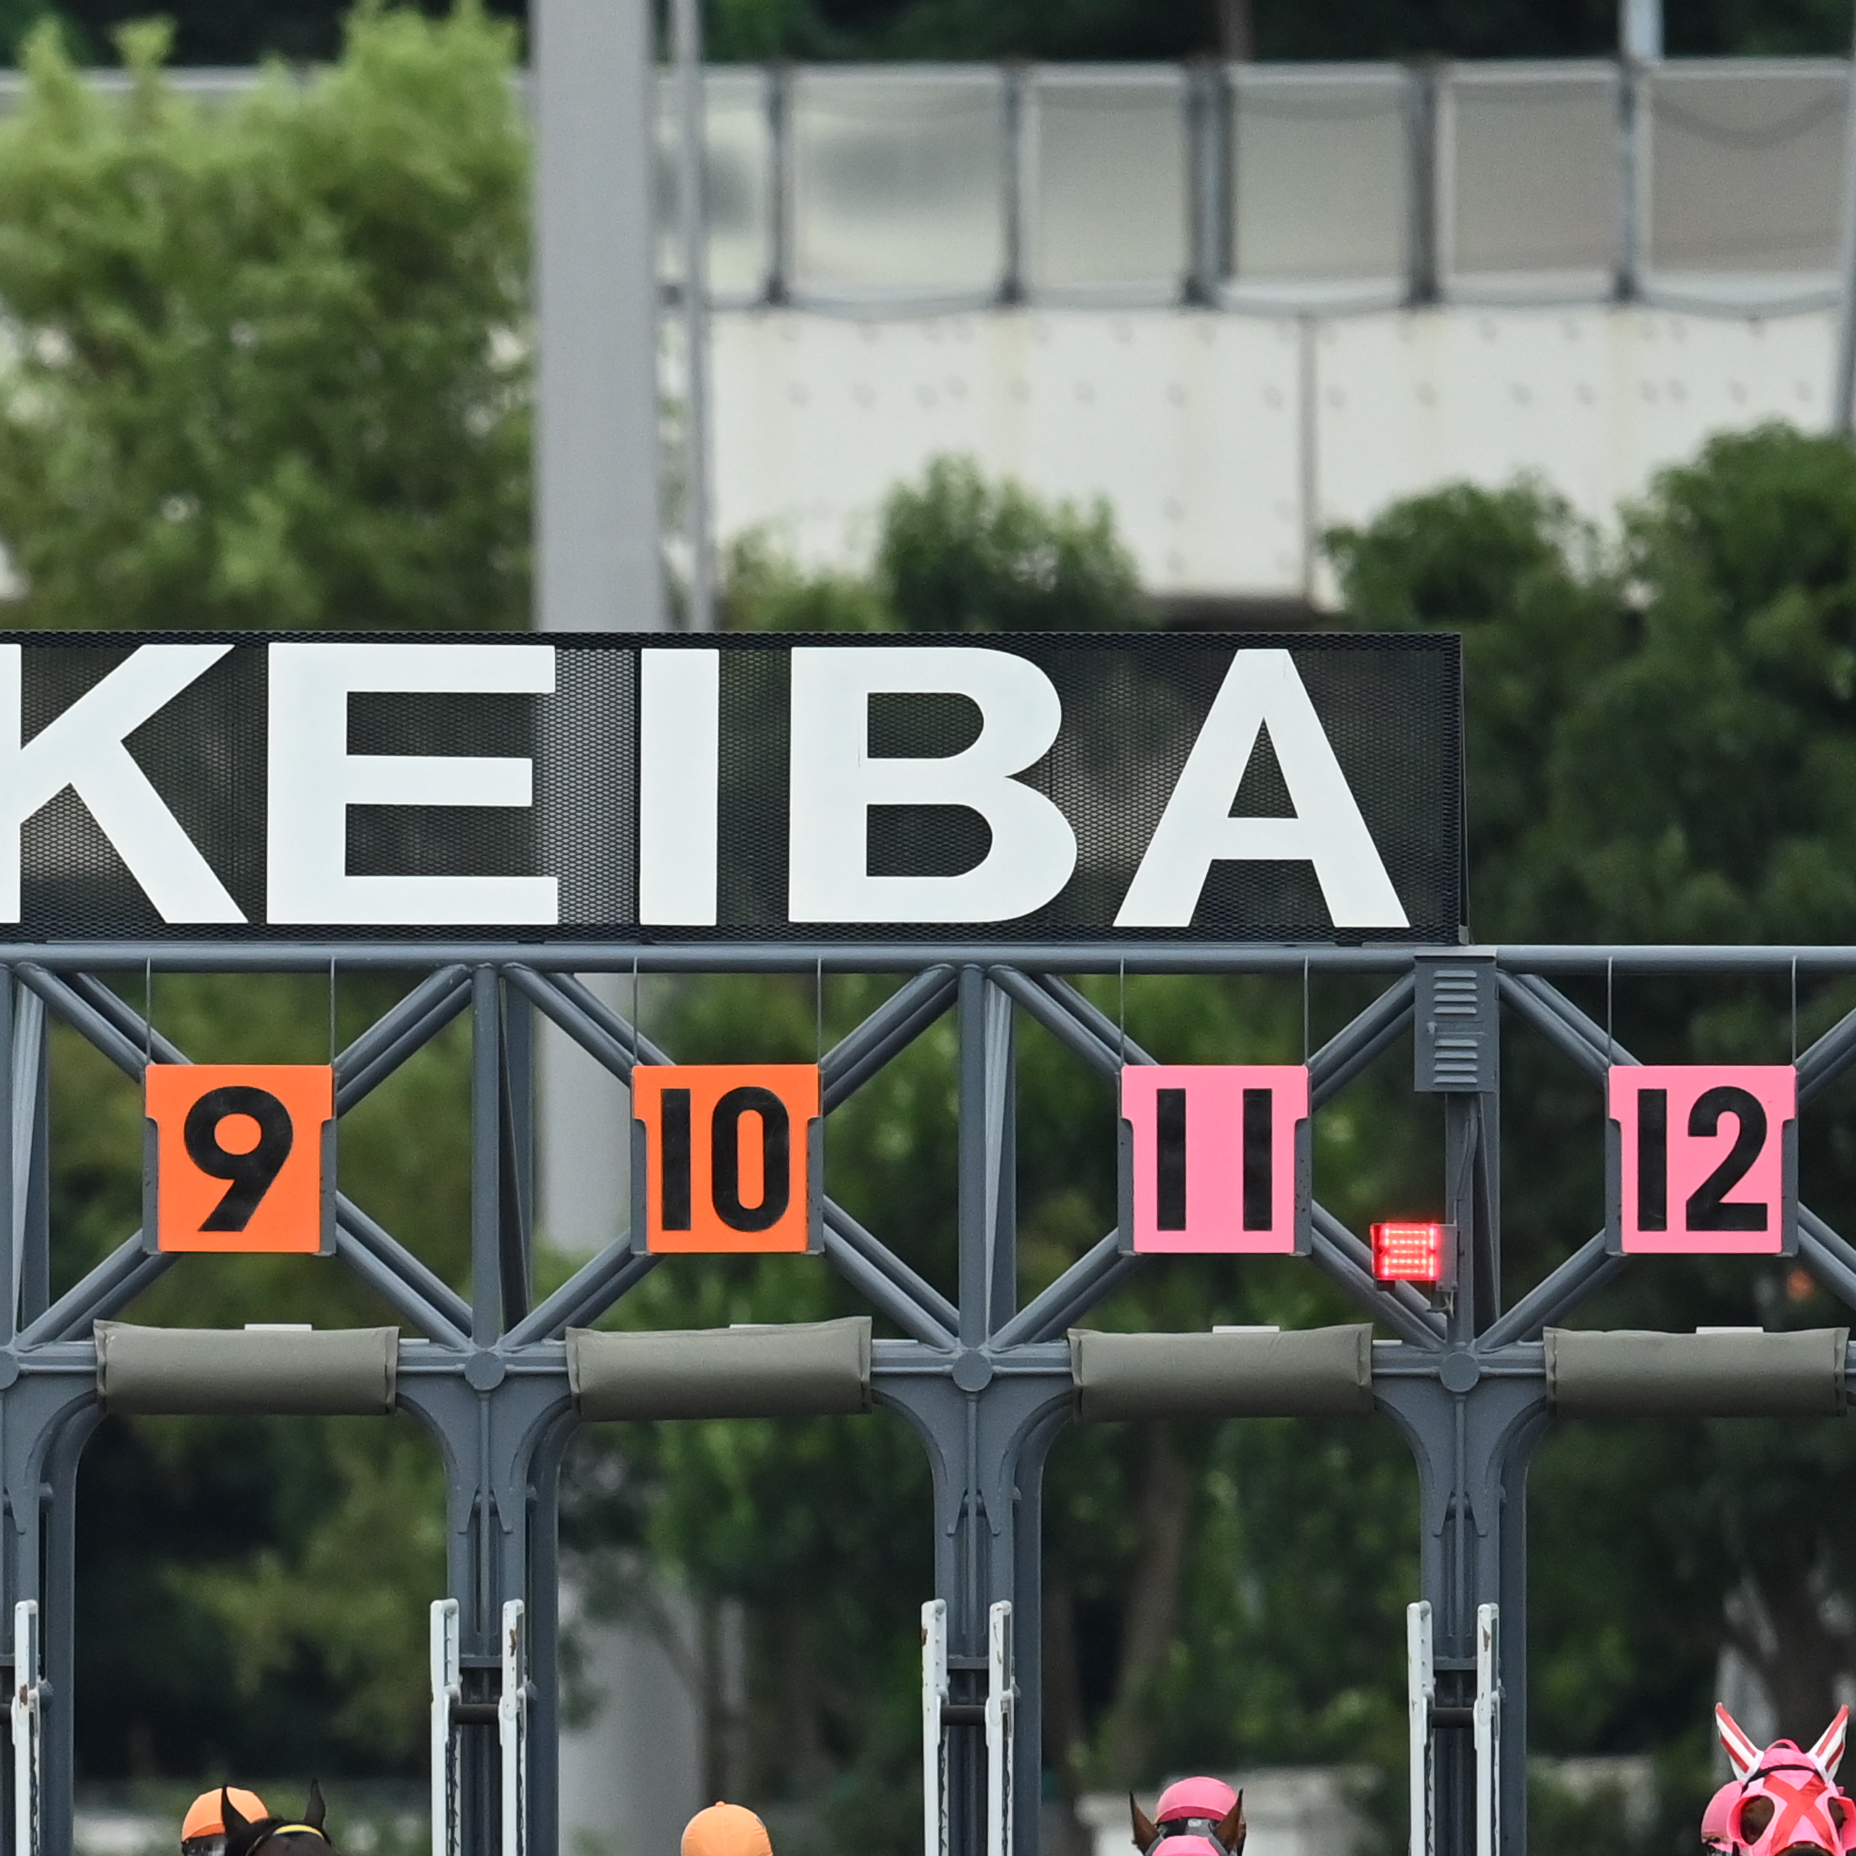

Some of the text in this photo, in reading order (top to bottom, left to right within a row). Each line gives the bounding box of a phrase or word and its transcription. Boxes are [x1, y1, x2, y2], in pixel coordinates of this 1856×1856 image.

[184, 1086, 293, 1232] 9
[661, 1086, 790, 1232] 10
[1157, 1088, 1273, 1231] 11
[1637, 1086, 1768, 1232] 12
